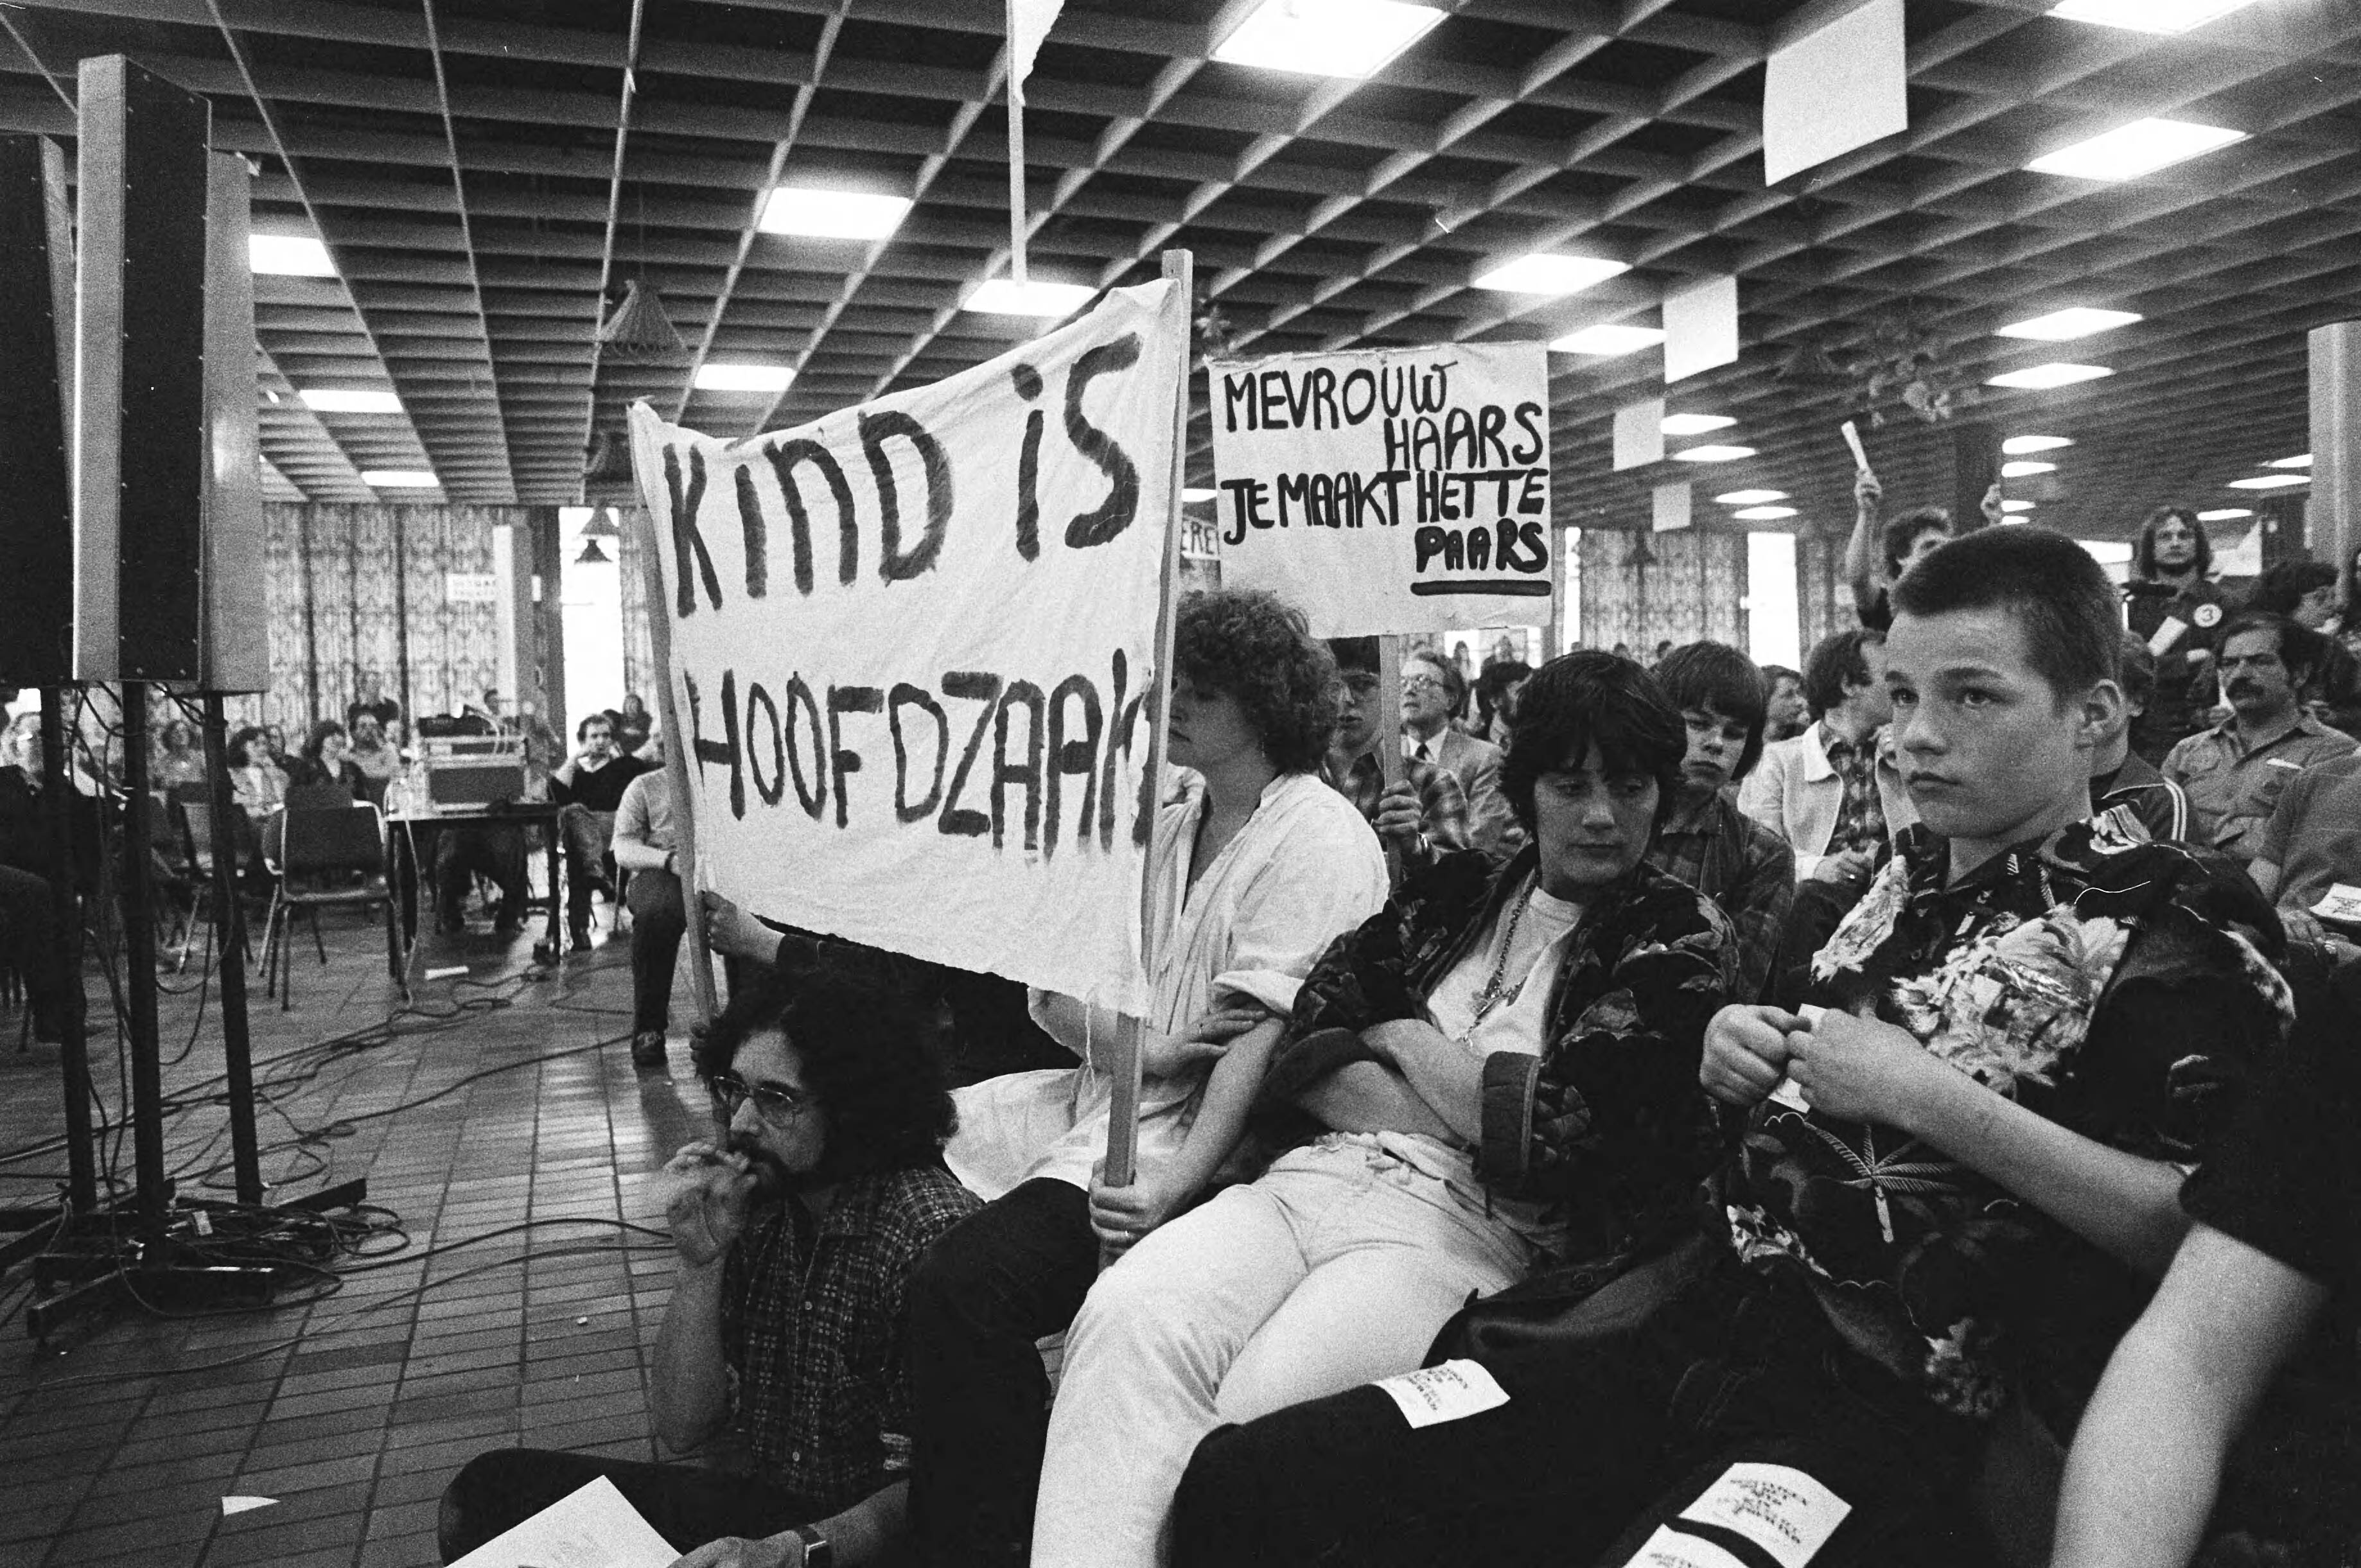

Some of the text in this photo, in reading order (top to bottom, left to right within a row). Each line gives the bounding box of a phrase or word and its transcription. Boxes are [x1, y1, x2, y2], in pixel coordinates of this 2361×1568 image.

[1224, 361, 1459, 431] MEVROUW
[1383, 402, 1543, 471] HAARS
[1220, 478, 1274, 544] JE
[1277, 472, 1411, 527] MAAKT
[1414, 518, 1549, 573] PAARS
